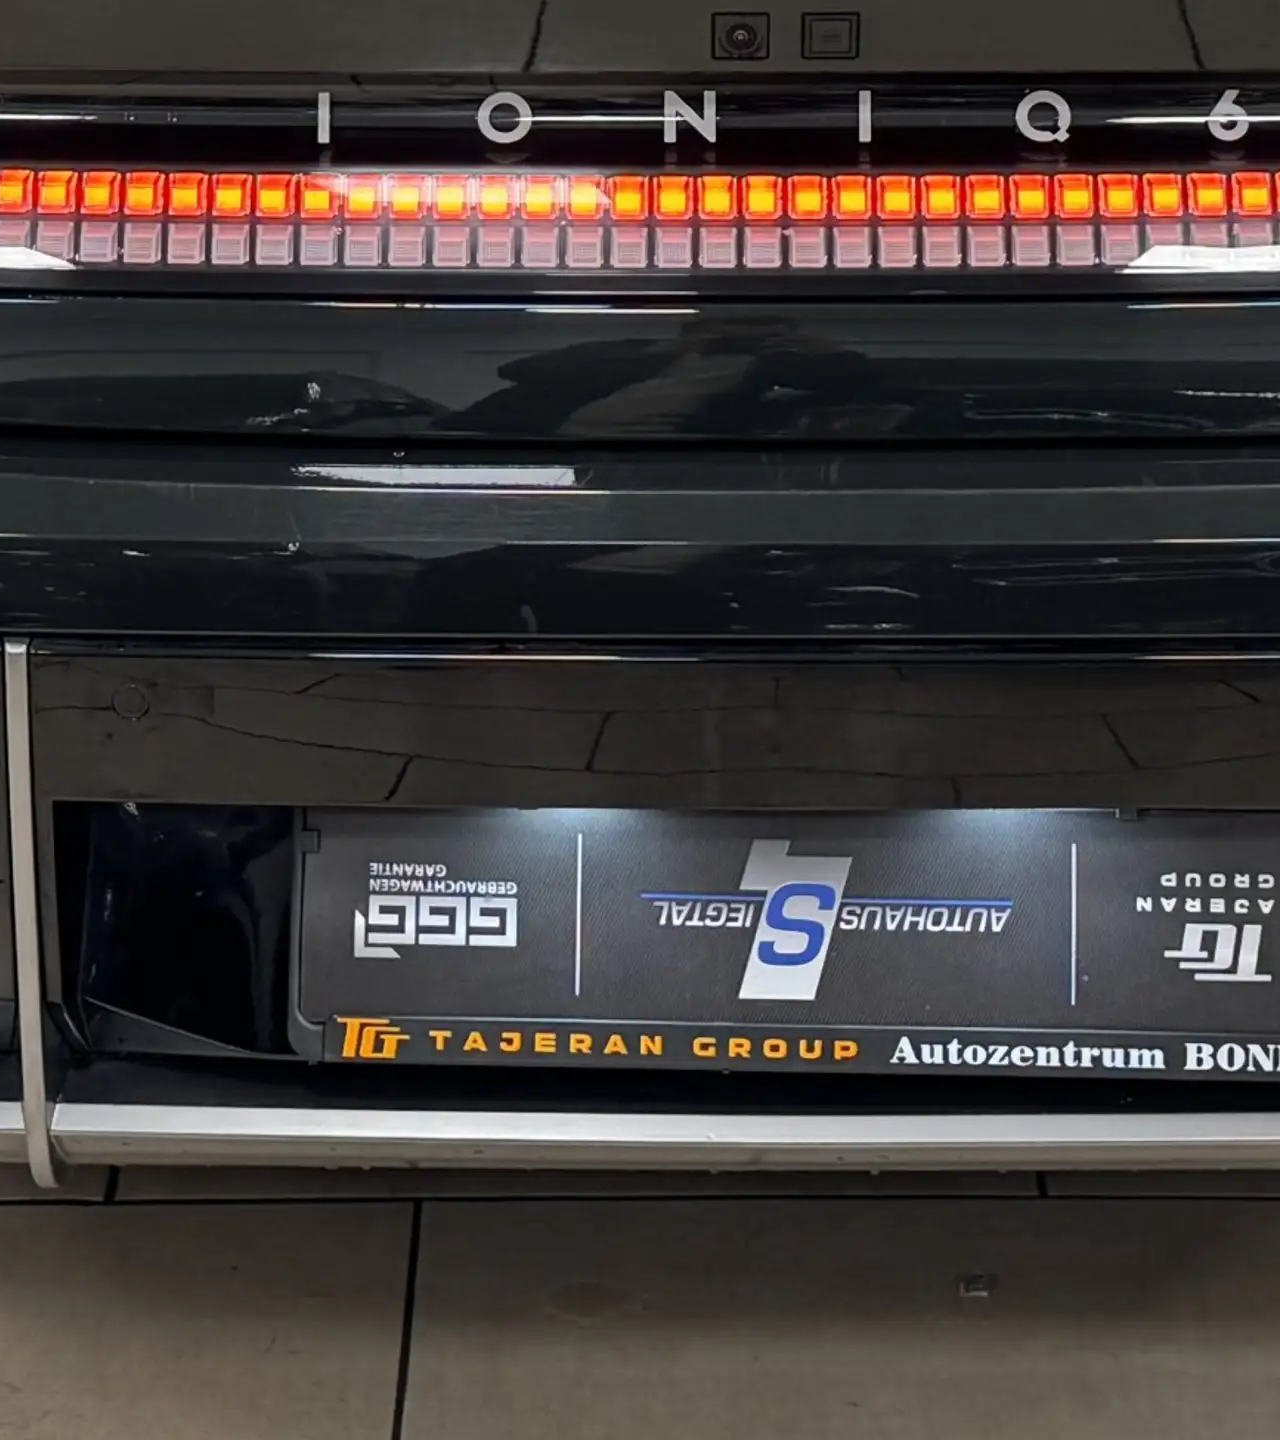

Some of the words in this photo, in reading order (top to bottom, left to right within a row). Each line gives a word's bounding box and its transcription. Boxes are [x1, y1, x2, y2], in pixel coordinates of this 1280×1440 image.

[317, 90, 1074, 144] IONIQ
[1208, 89, 1250, 143] 6
[368, 862, 447, 878] GARANTIE
[1159, 871, 1276, 890] GROUP
[368, 879, 518, 895] GEBRAUCHTWAGEN
[367, 895, 518, 948] GGG
[838, 904, 1012, 932] AUTOHAUS
[428, 1030, 665, 1058] TAJERAN
[693, 1035, 860, 1061] GROUP
[889, 1036, 1167, 1072] Autozentrum
